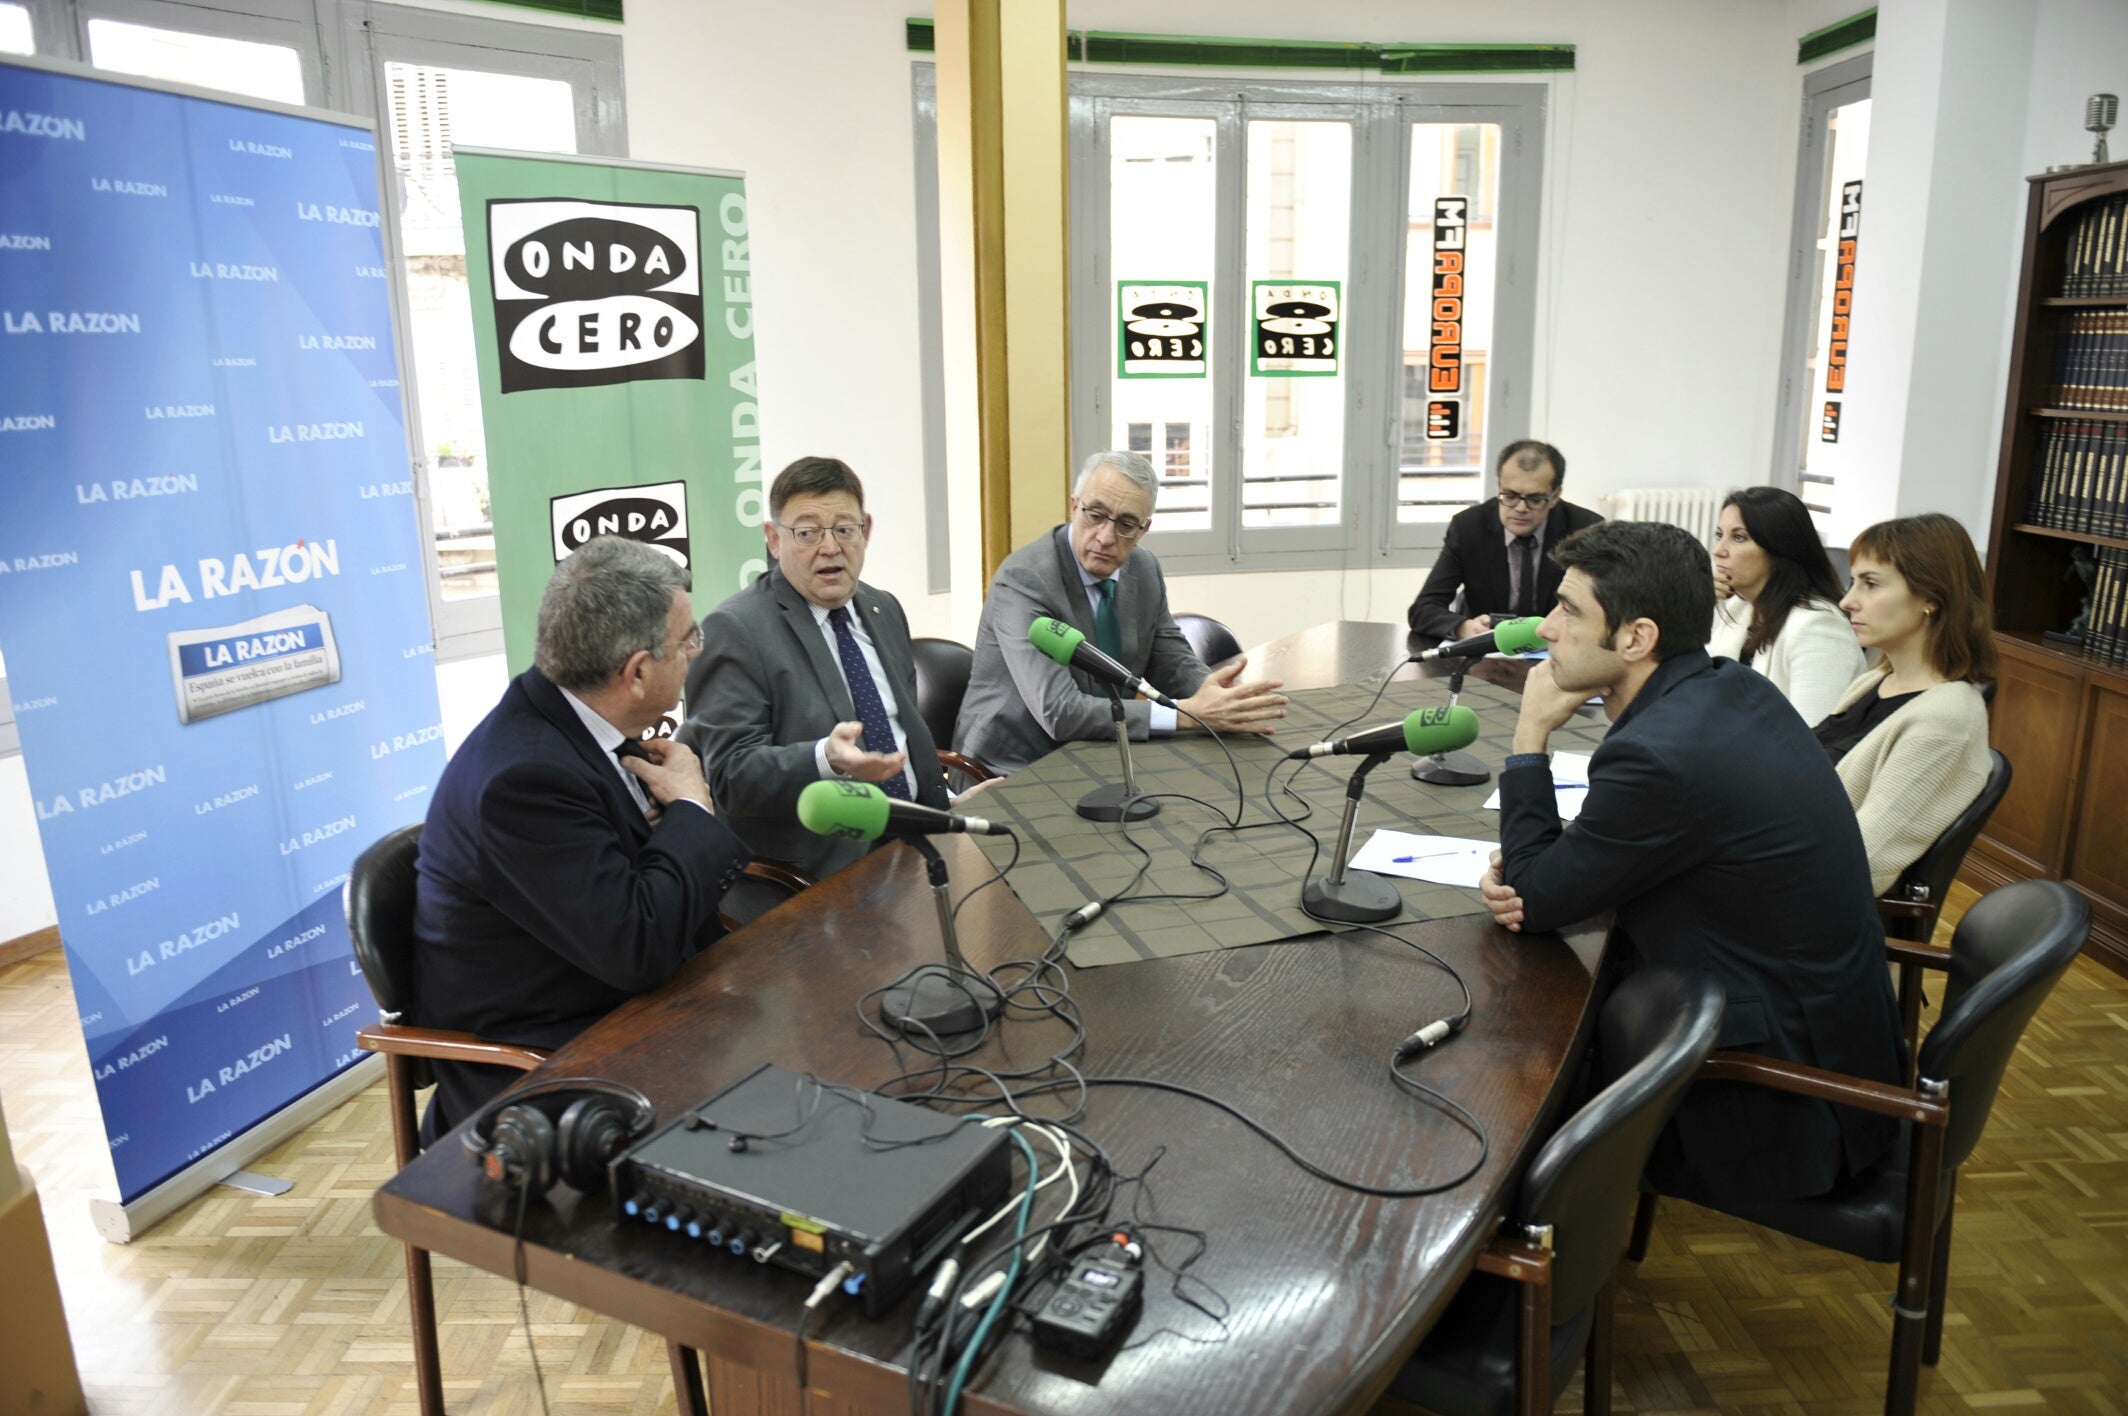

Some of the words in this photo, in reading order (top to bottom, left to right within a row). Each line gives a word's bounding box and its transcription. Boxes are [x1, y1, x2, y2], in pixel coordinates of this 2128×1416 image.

[229, 139, 246, 151] LA
[92, 177, 111, 192] LA
[297, 203, 323, 221] LA
[521, 239, 671, 278] ONDA
[719, 192, 753, 339] CERO
[190, 262, 213, 277] LA
[4, 311, 43, 333] LA
[299, 335, 320, 349] LA
[538, 312, 674, 354] CERO
[145, 407, 164, 419] LA
[269, 426, 294, 443] LA
[729, 359, 762, 528] ONDA
[76, 483, 108, 504] LA
[361, 484, 380, 499] LA
[572, 508, 669, 543] ONDA
[130, 565, 193, 612] LA
[198, 538, 340, 600] RAZÓN
[204, 643, 234, 668] LA
[311, 713, 326, 724] LA
[642, 721, 672, 741] DA
[371, 742, 390, 760] LA
[36, 795, 74, 820] LA
[195, 802, 213, 815] LA
[280, 838, 300, 855] LA
[86, 900, 108, 915] LA
[267, 945, 283, 959] LA
[127, 950, 156, 976] LA
[217, 1003, 229, 1013] LA
[95, 1064, 116, 1080] LA
[187, 1078, 216, 1104] LA
